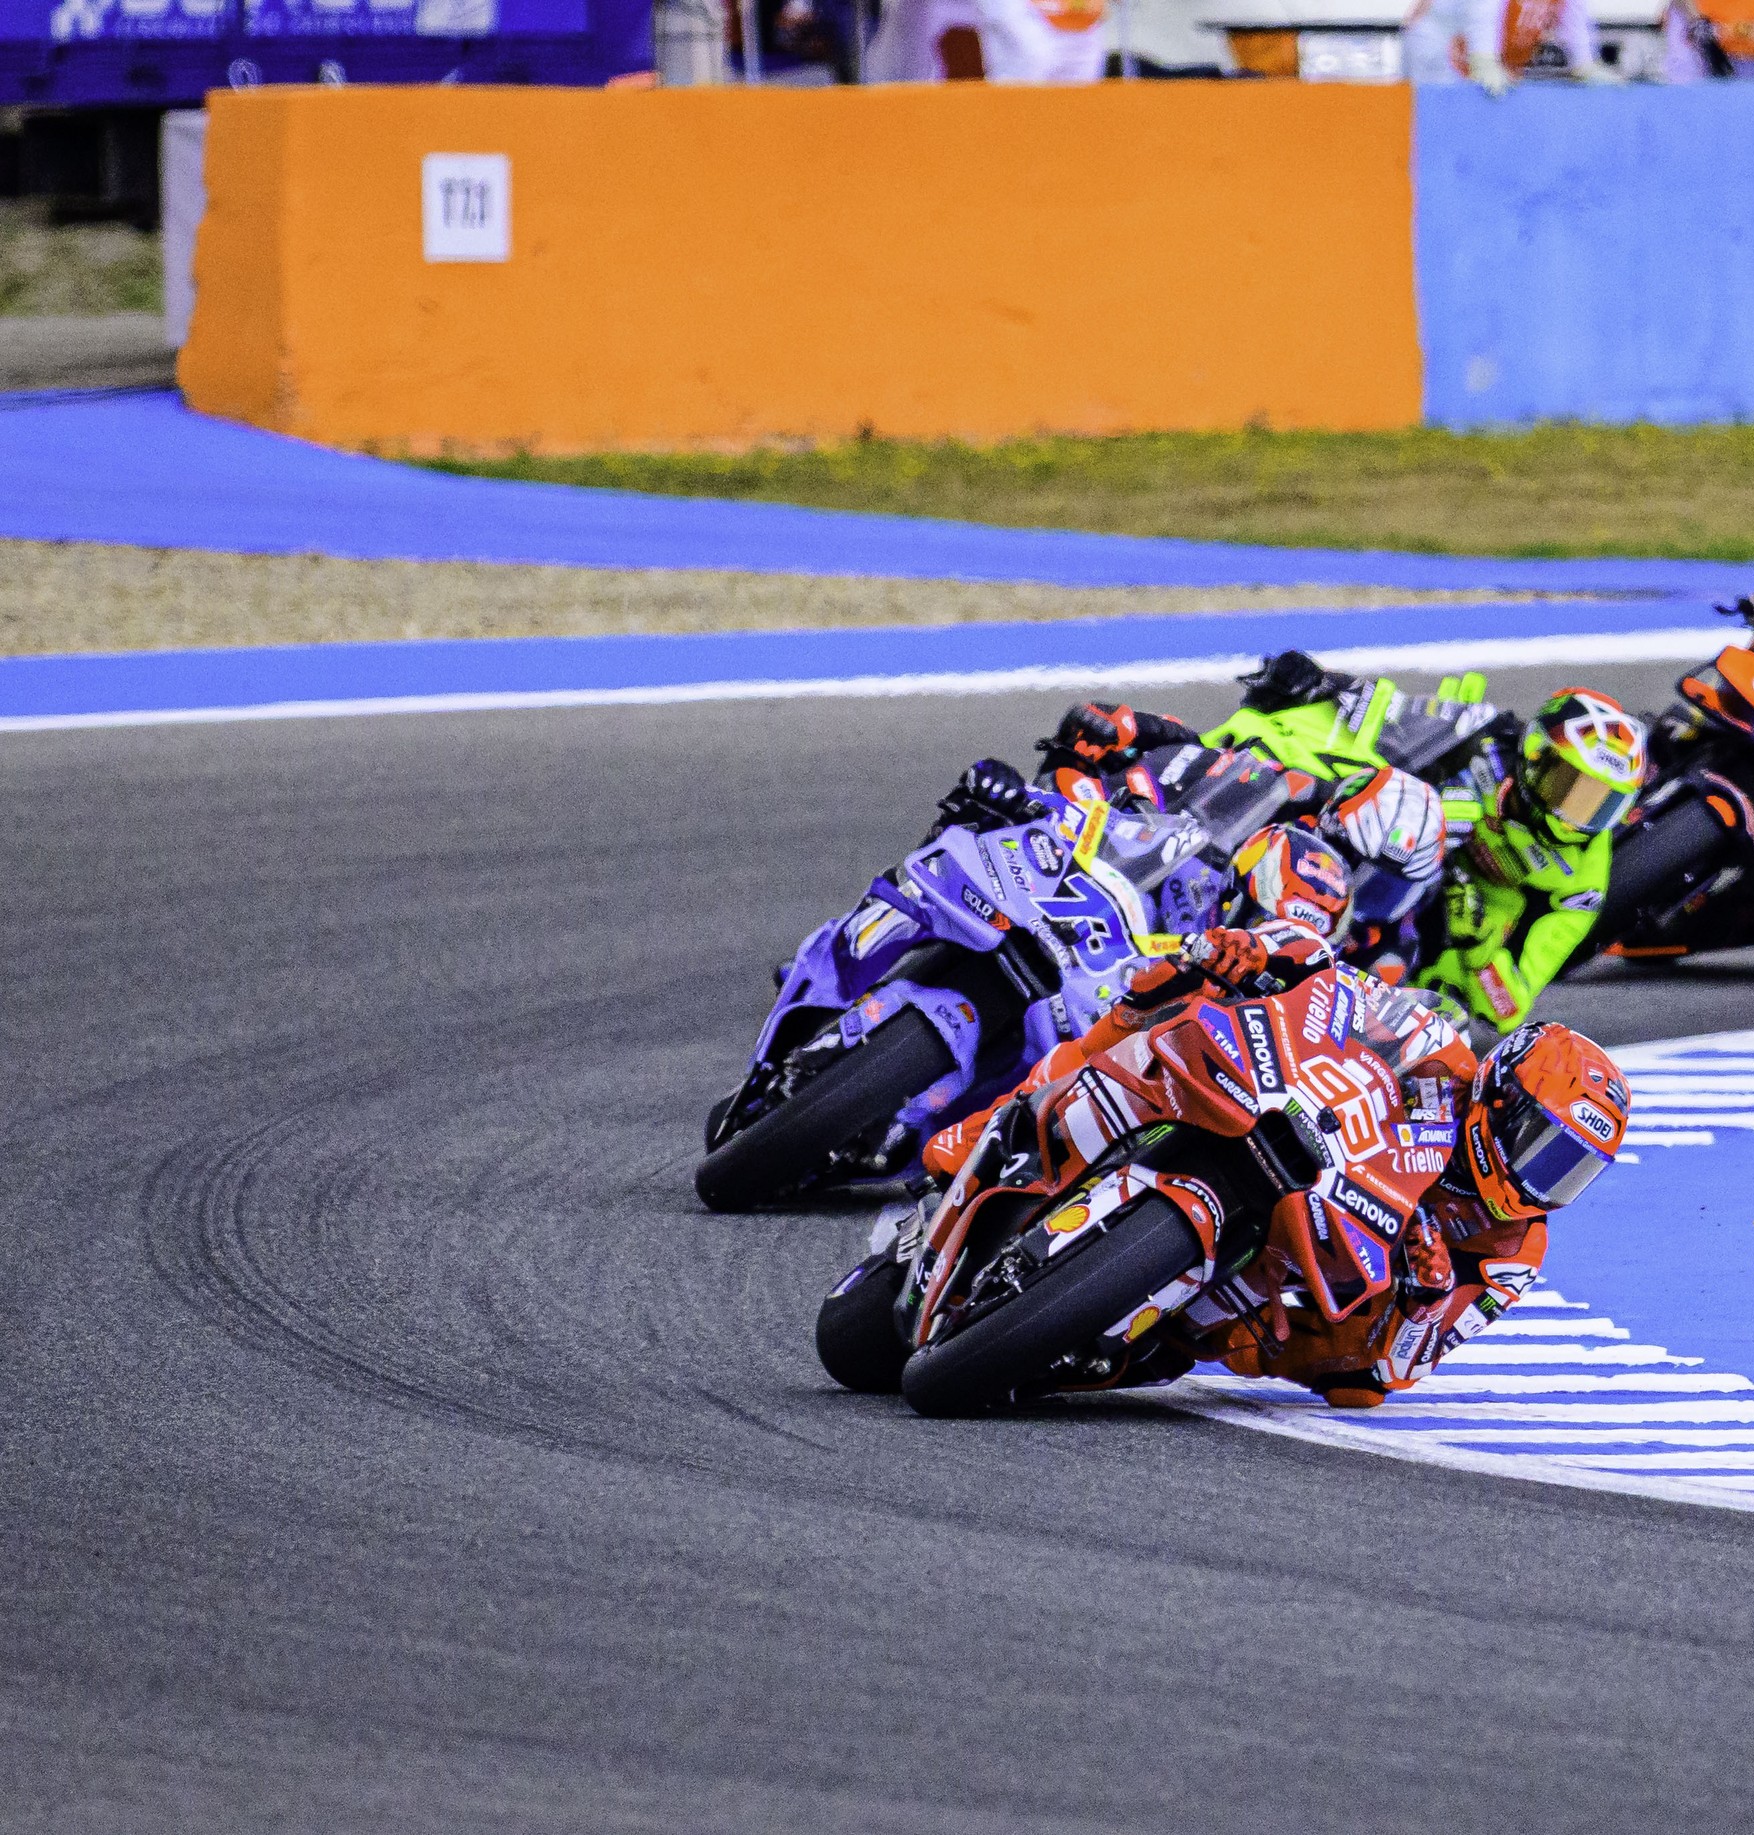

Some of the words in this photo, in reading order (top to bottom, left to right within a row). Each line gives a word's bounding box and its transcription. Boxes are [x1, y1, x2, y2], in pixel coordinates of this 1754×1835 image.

[1302, 987, 1331, 1044] riello
[1213, 1030, 1240, 1060] TIM
[1243, 1008, 1278, 1088] Lenovo
[1215, 1072, 1261, 1115] CARRERA
[1299, 1054, 1388, 1163] 93
[1403, 1147, 1445, 1173] riello
[1471, 1125, 1489, 1173] Lenovo
[1172, 1178, 1222, 1242] Lenovo
[1334, 1178, 1399, 1235] Lenovo
